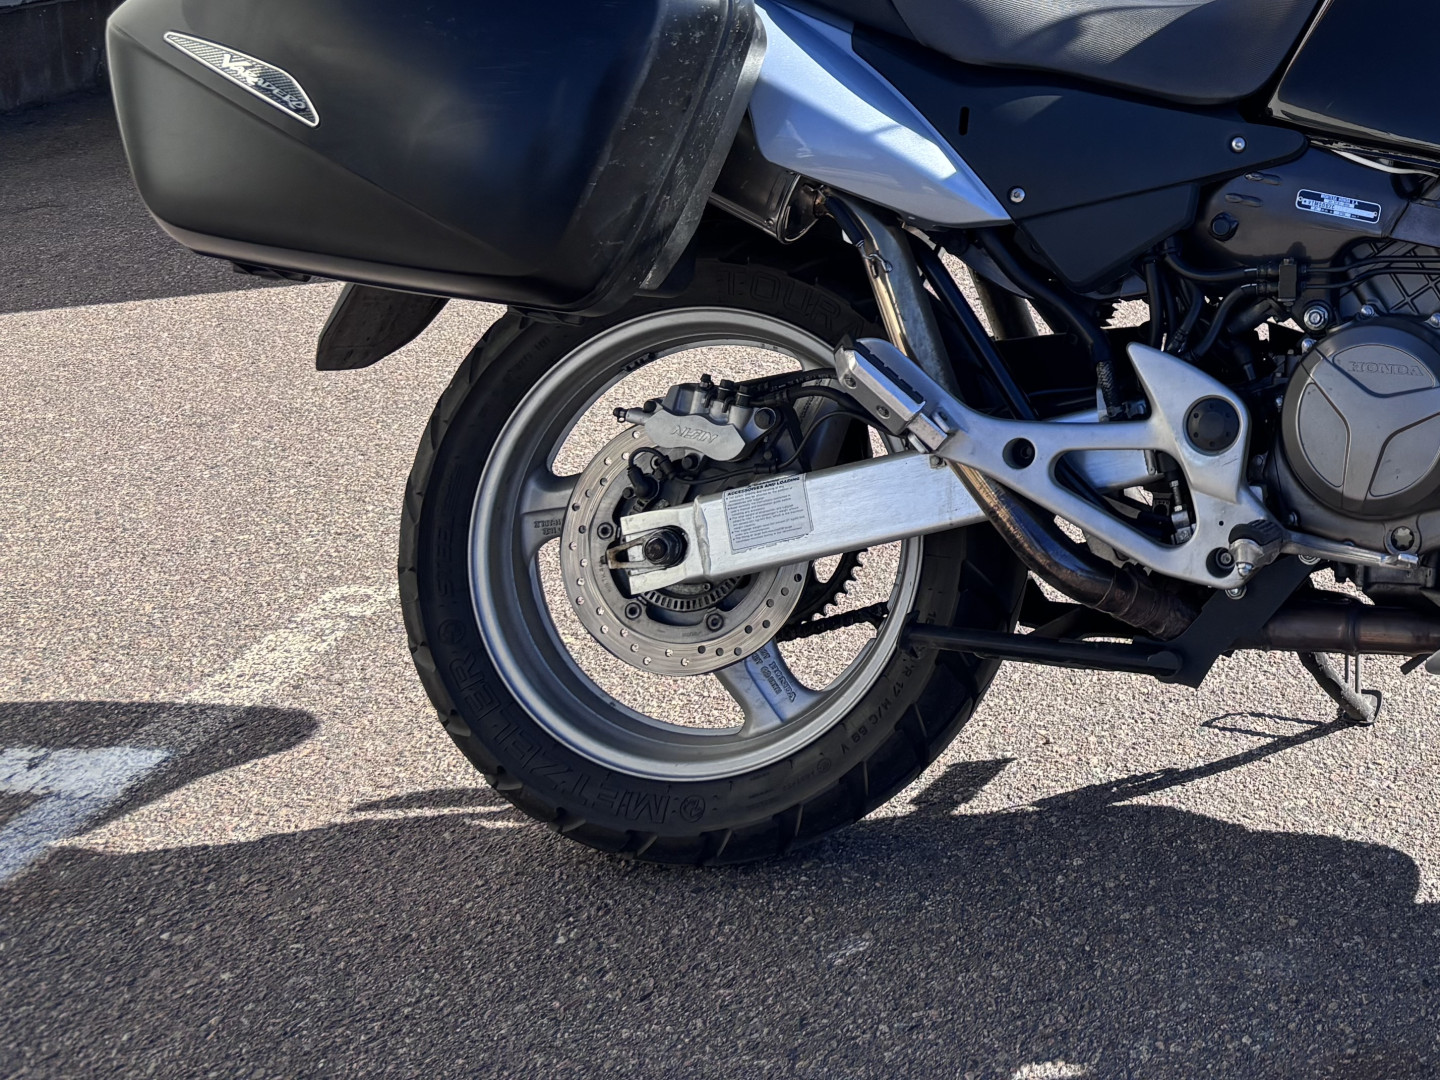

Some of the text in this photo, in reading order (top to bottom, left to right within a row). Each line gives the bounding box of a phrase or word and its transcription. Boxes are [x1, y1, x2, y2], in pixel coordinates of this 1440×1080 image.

[1349, 361, 1424, 376] HONDA
[727, 477, 800, 496] ACCESSORIES AND LOADING
[450, 648, 671, 824] METZELER
